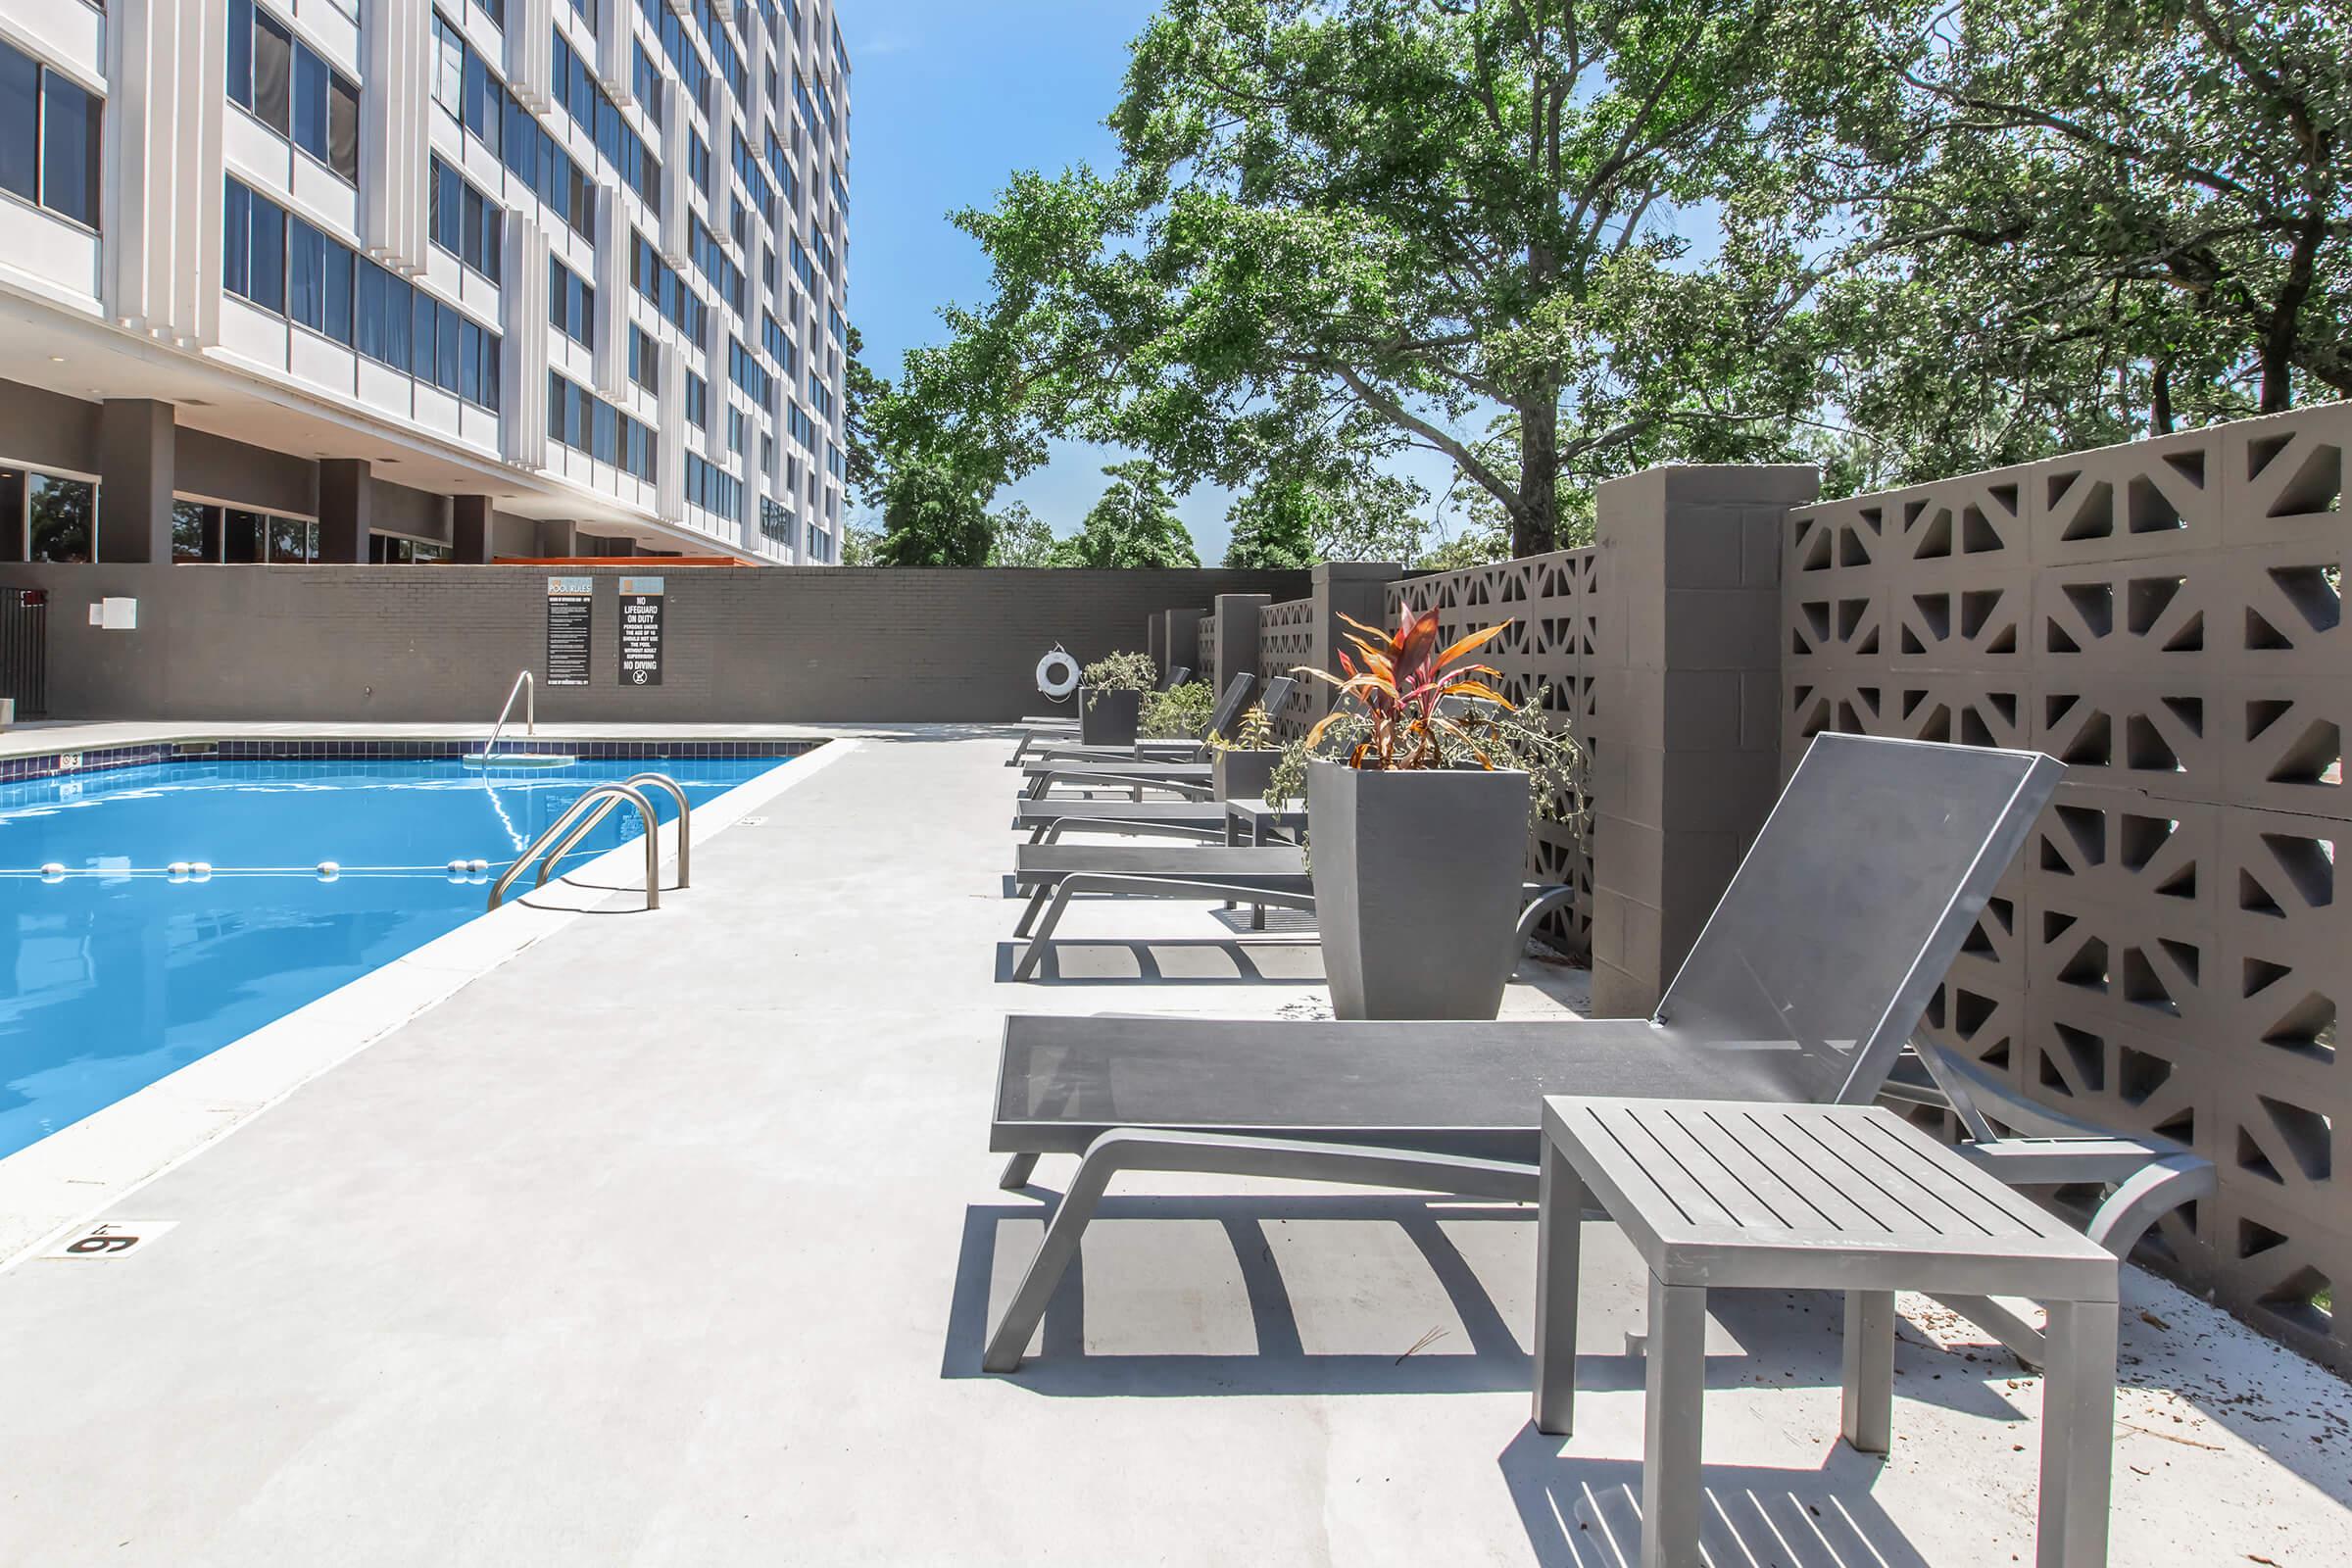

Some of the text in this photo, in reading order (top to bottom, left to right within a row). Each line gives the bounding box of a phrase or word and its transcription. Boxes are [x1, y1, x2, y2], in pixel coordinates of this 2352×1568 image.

[636, 596, 646, 605] NO
[624, 606, 659, 614] LIFEGUARD
[627, 614, 655, 623] ON DUTY
[623, 661, 657, 670] NO DIVING
